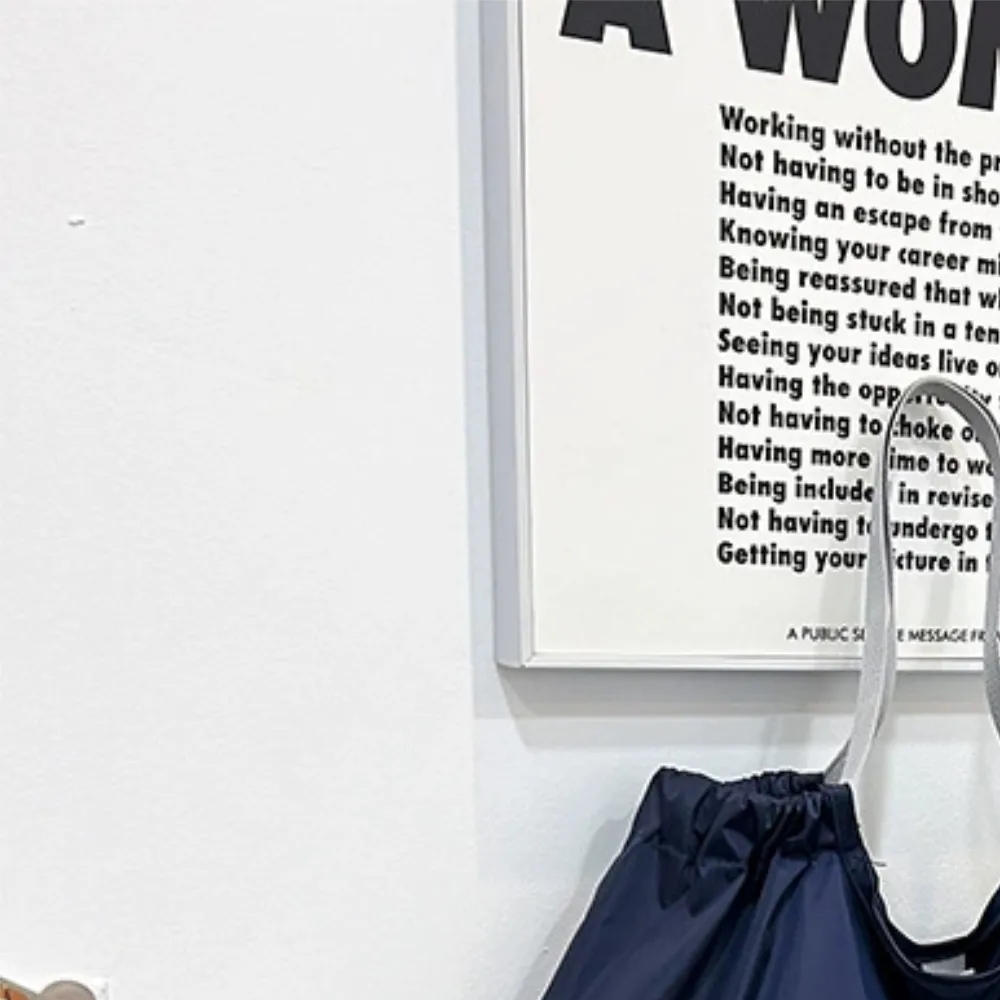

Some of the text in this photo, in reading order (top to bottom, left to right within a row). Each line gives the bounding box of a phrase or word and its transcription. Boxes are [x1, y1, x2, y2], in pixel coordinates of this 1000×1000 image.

[719, 104, 826, 152] Working
[834, 125, 927, 161] without
[935, 139, 972, 167] the
[720, 142, 764, 173] Not
[773, 149, 856, 193] having
[865, 166, 889, 190] to
[897, 168, 925, 196] be
[933, 173, 954, 200] in
[719, 180, 806, 222] Having
[814, 200, 845, 221] an
[853, 206, 931, 236] escape
[939, 210, 992, 241] from
[719, 217, 828, 262] Knowing
[836, 239, 891, 264] your
[898, 247, 970, 272] career
[719, 255, 790, 293] Being
[798, 270, 917, 301] reassured
[924, 279, 971, 307] that
[719, 291, 762, 319] Not
[770, 296, 839, 334] being
[847, 309, 907, 335] stuck
[914, 311, 935, 338] in
[943, 322, 957, 340] a
[718, 327, 800, 366] Seeing
[807, 343, 862, 368] your
[870, 341, 931, 371] ideas
[938, 348, 979, 376] live
[718, 364, 803, 401] Having
[812, 372, 851, 398] the
[718, 400, 762, 426] Not
[770, 402, 850, 439] having
[858, 413, 883, 436] to
[718, 435, 803, 471] Having
[811, 448, 871, 469] more
[889, 446, 930, 472] ime
[937, 452, 960, 475] to
[718, 471, 787, 504] Being
[795, 475, 875, 503] include
[898, 481, 920, 505] in
[927, 485, 994, 509] revise
[718, 506, 760, 531] Not
[768, 507, 849, 542] having
[717, 540, 807, 573] Getting
[814, 550, 868, 574] your
[957, 550, 978, 573] in
[787, 627, 798, 641] A
[801, 627, 849, 642] PUBLIC
[907, 629, 966, 642] MESSAGE
